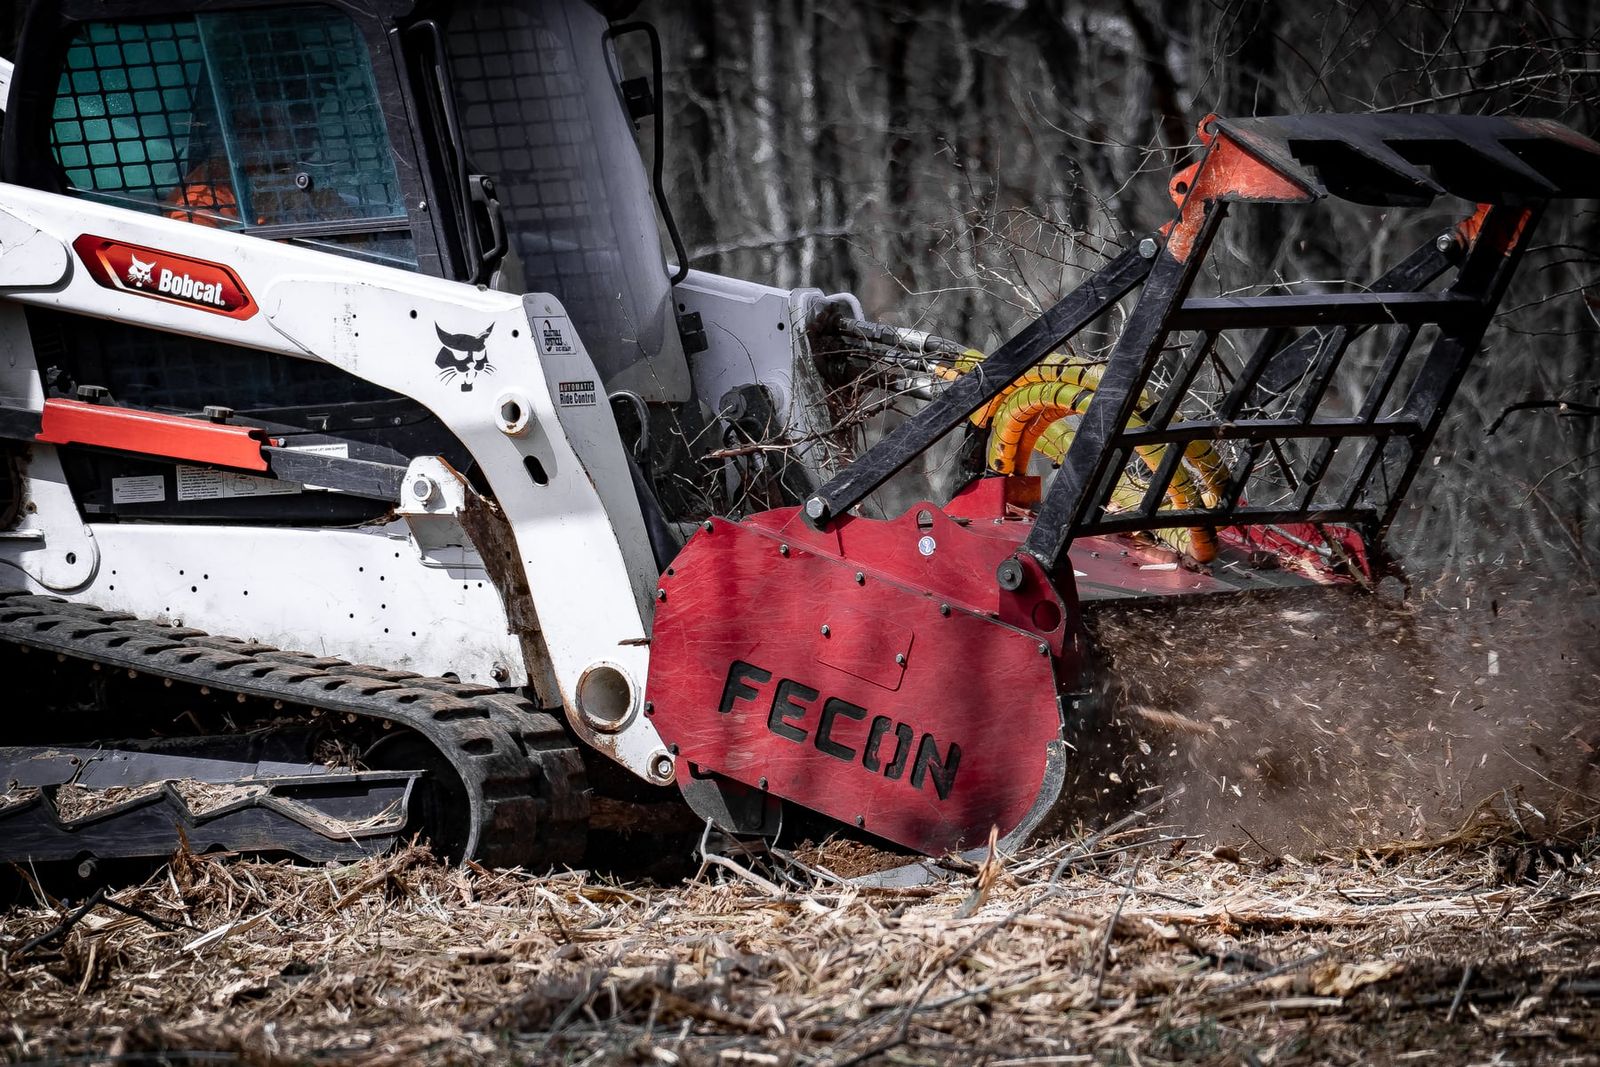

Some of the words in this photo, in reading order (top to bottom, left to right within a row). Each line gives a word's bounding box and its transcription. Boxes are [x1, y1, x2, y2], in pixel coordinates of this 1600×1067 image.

[560, 383, 594, 392] AUTOMATIC
[560, 393, 573, 404] Ride
[574, 392, 596, 404] Control
[718, 659, 962, 801] FECON
